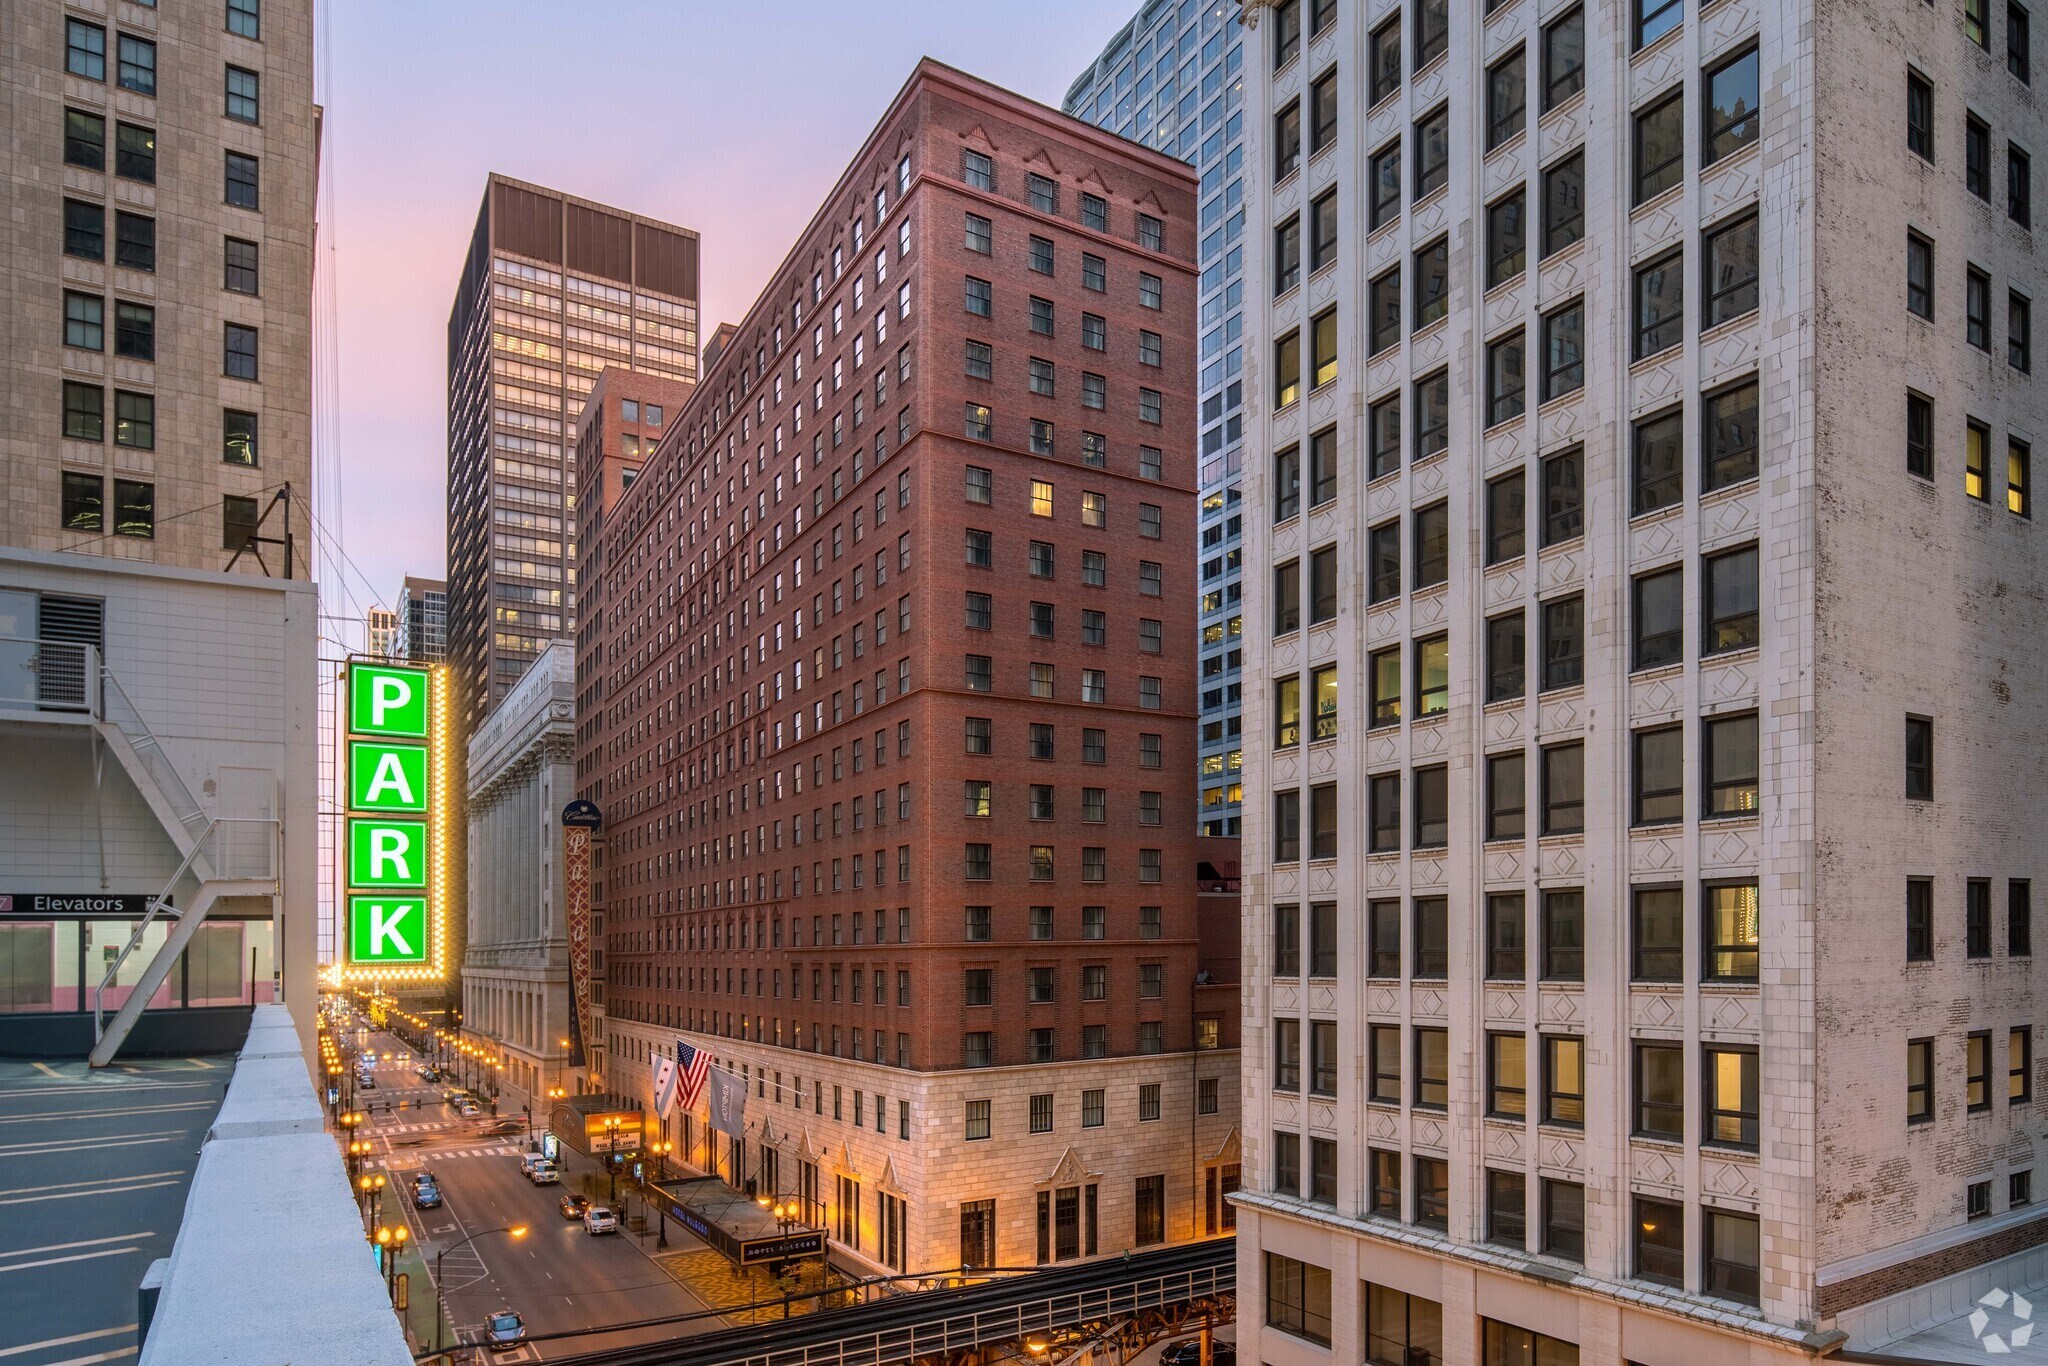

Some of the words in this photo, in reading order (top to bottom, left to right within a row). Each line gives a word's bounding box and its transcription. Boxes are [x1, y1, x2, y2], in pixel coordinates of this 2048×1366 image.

[365, 676, 415, 956] PARK
[564, 810, 600, 821] Cadillac
[34, 896, 124, 911] Elevators
[568, 833, 588, 996] Palace
